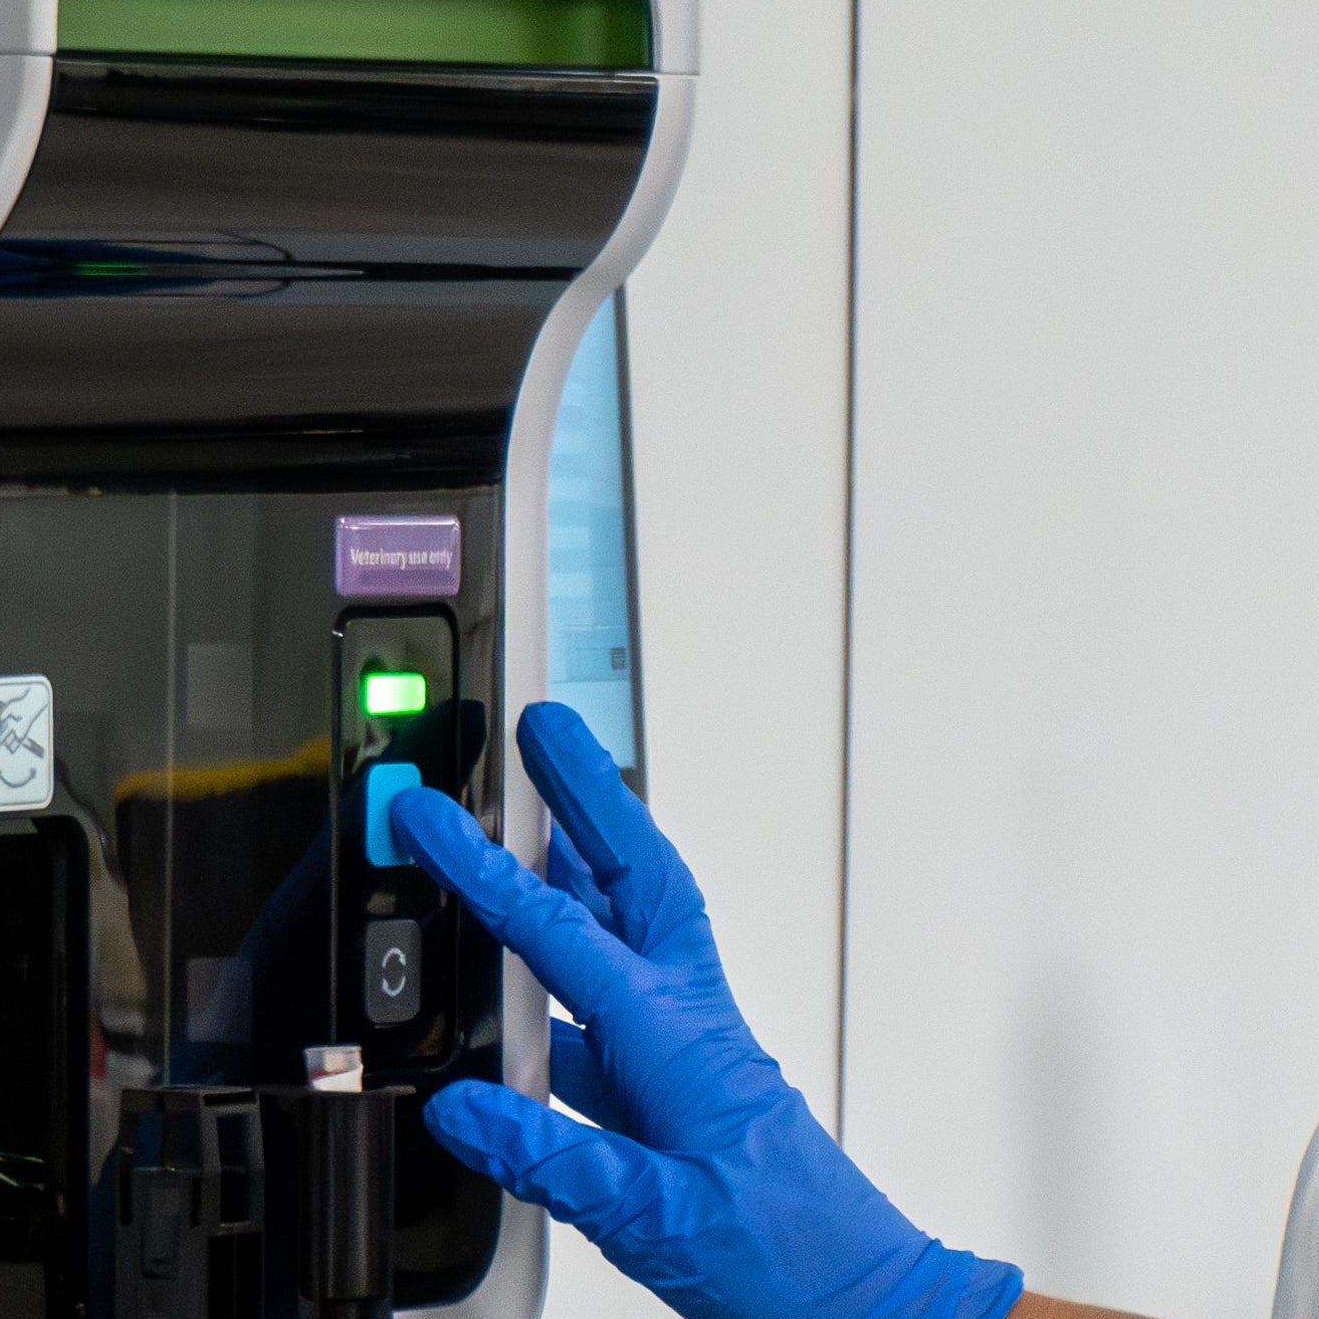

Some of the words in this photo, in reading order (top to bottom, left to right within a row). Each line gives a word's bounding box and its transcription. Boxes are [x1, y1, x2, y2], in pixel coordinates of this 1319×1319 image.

[350, 548, 406, 570] Veterinary
[408, 550, 428, 565] use
[429, 549, 453, 570] only
